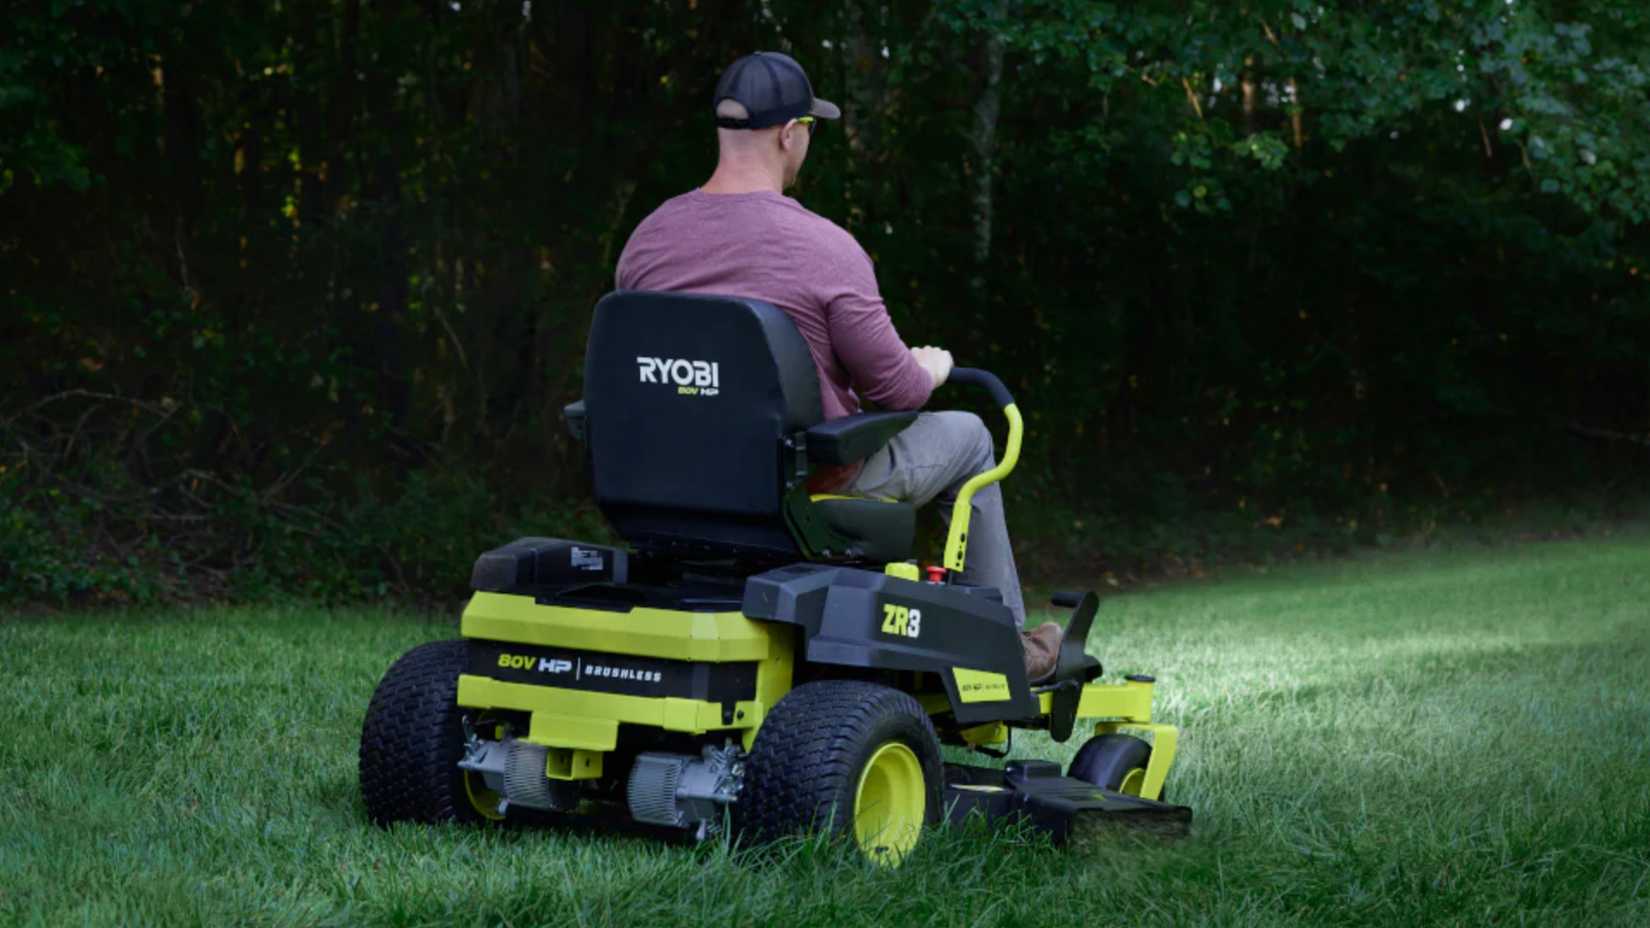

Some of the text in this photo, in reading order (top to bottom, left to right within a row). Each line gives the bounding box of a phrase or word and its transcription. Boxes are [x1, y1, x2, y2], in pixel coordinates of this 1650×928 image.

[636, 356, 719, 388] RYOBI
[881, 603, 921, 638] ZR3
[498, 653, 662, 683] 80V HP BRUSHLESS
